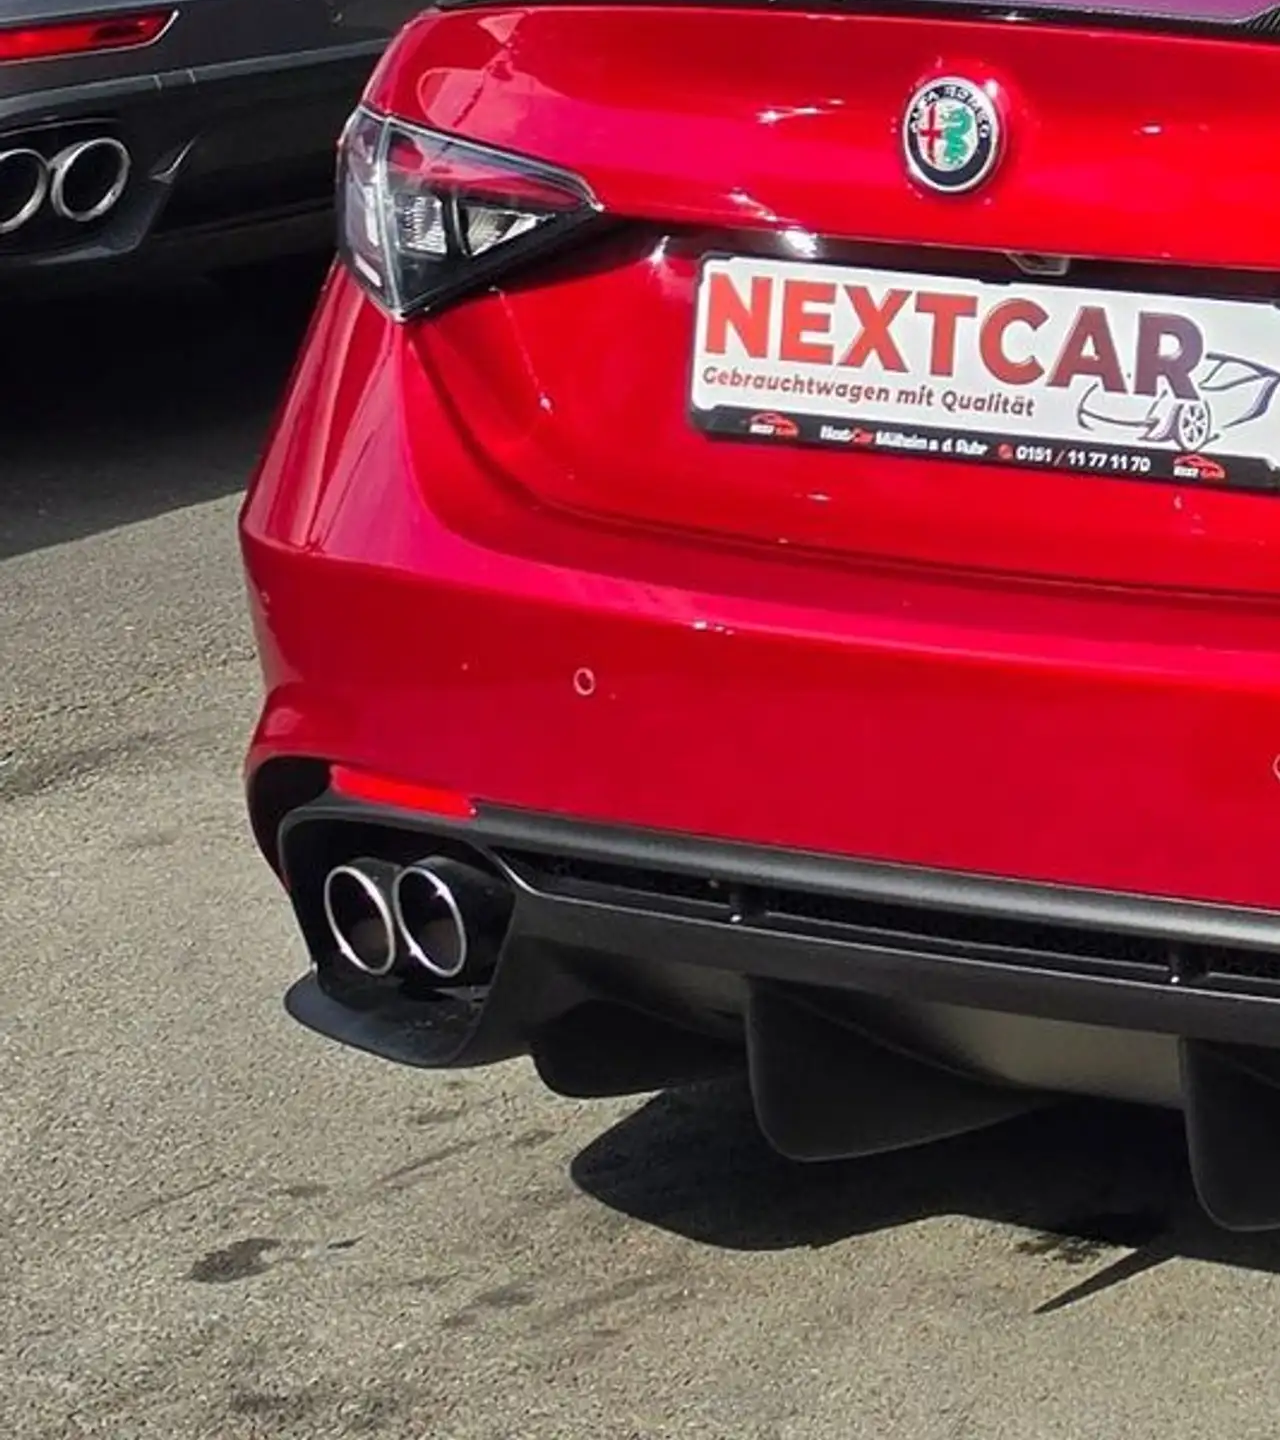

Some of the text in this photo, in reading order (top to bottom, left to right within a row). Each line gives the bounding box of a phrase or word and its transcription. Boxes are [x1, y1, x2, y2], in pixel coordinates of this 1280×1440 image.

[704, 271, 1205, 402] NEXTCAR
[702, 366, 1035, 417] Gebrauchtwagen mit Qualität
[1015, 445, 1053, 462] 0151
